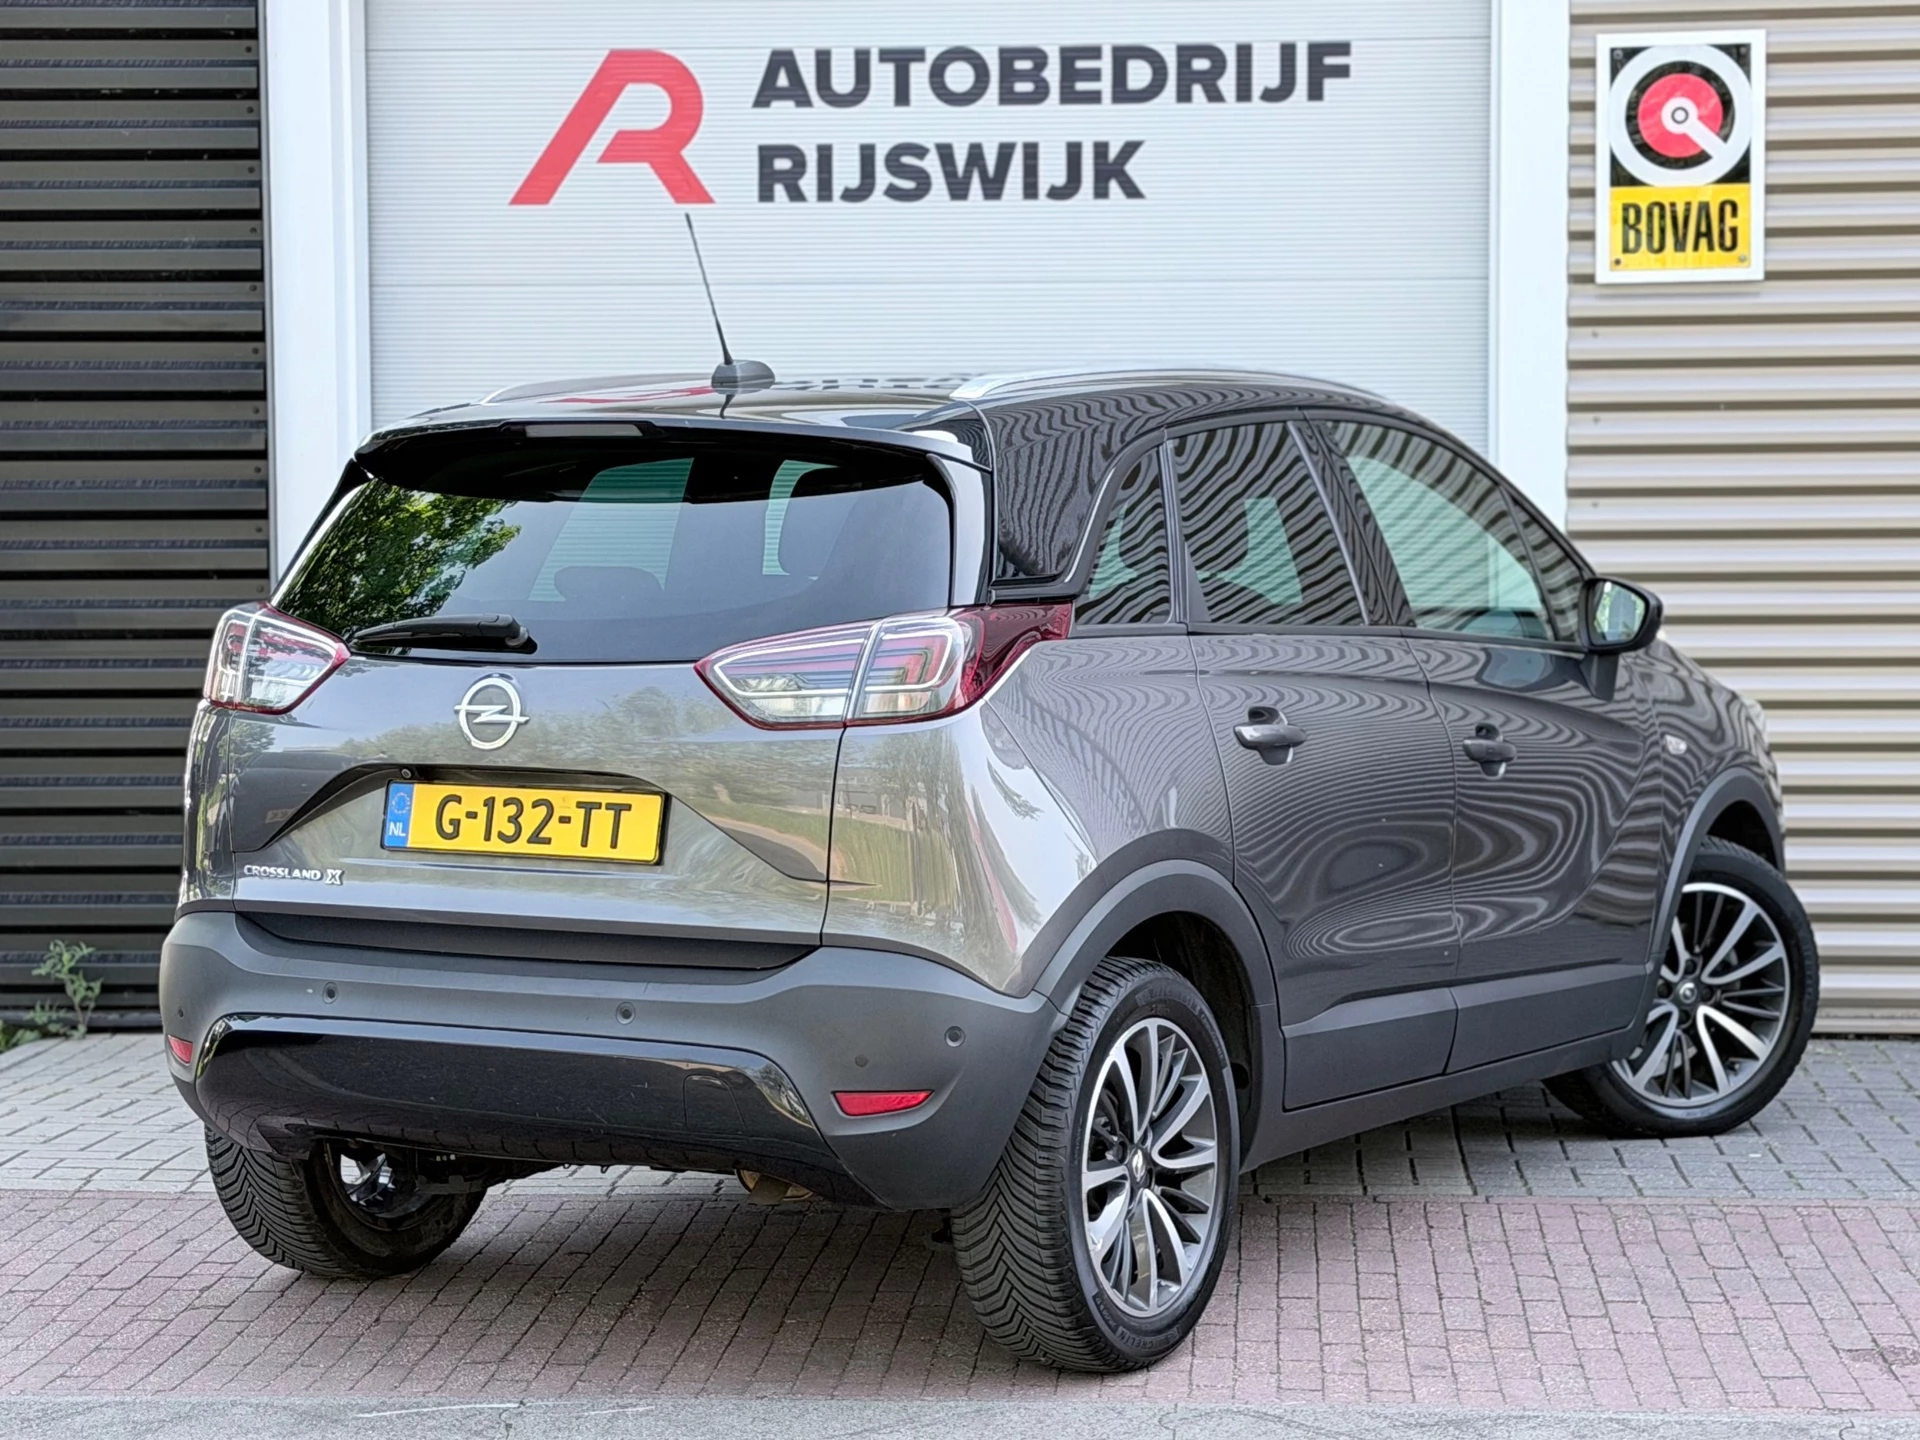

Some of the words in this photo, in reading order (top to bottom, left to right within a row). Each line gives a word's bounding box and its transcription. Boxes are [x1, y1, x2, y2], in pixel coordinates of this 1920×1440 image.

[752, 42, 1351, 108] AUTOBEDRIJF
[758, 141, 1146, 203] RIJSWIJK
[1621, 199, 1739, 254] BOVAG
[389, 821, 406, 837] NL
[435, 794, 632, 849] G-132-TT
[243, 864, 321, 880] CROSSLAND
[325, 868, 344, 885] X
